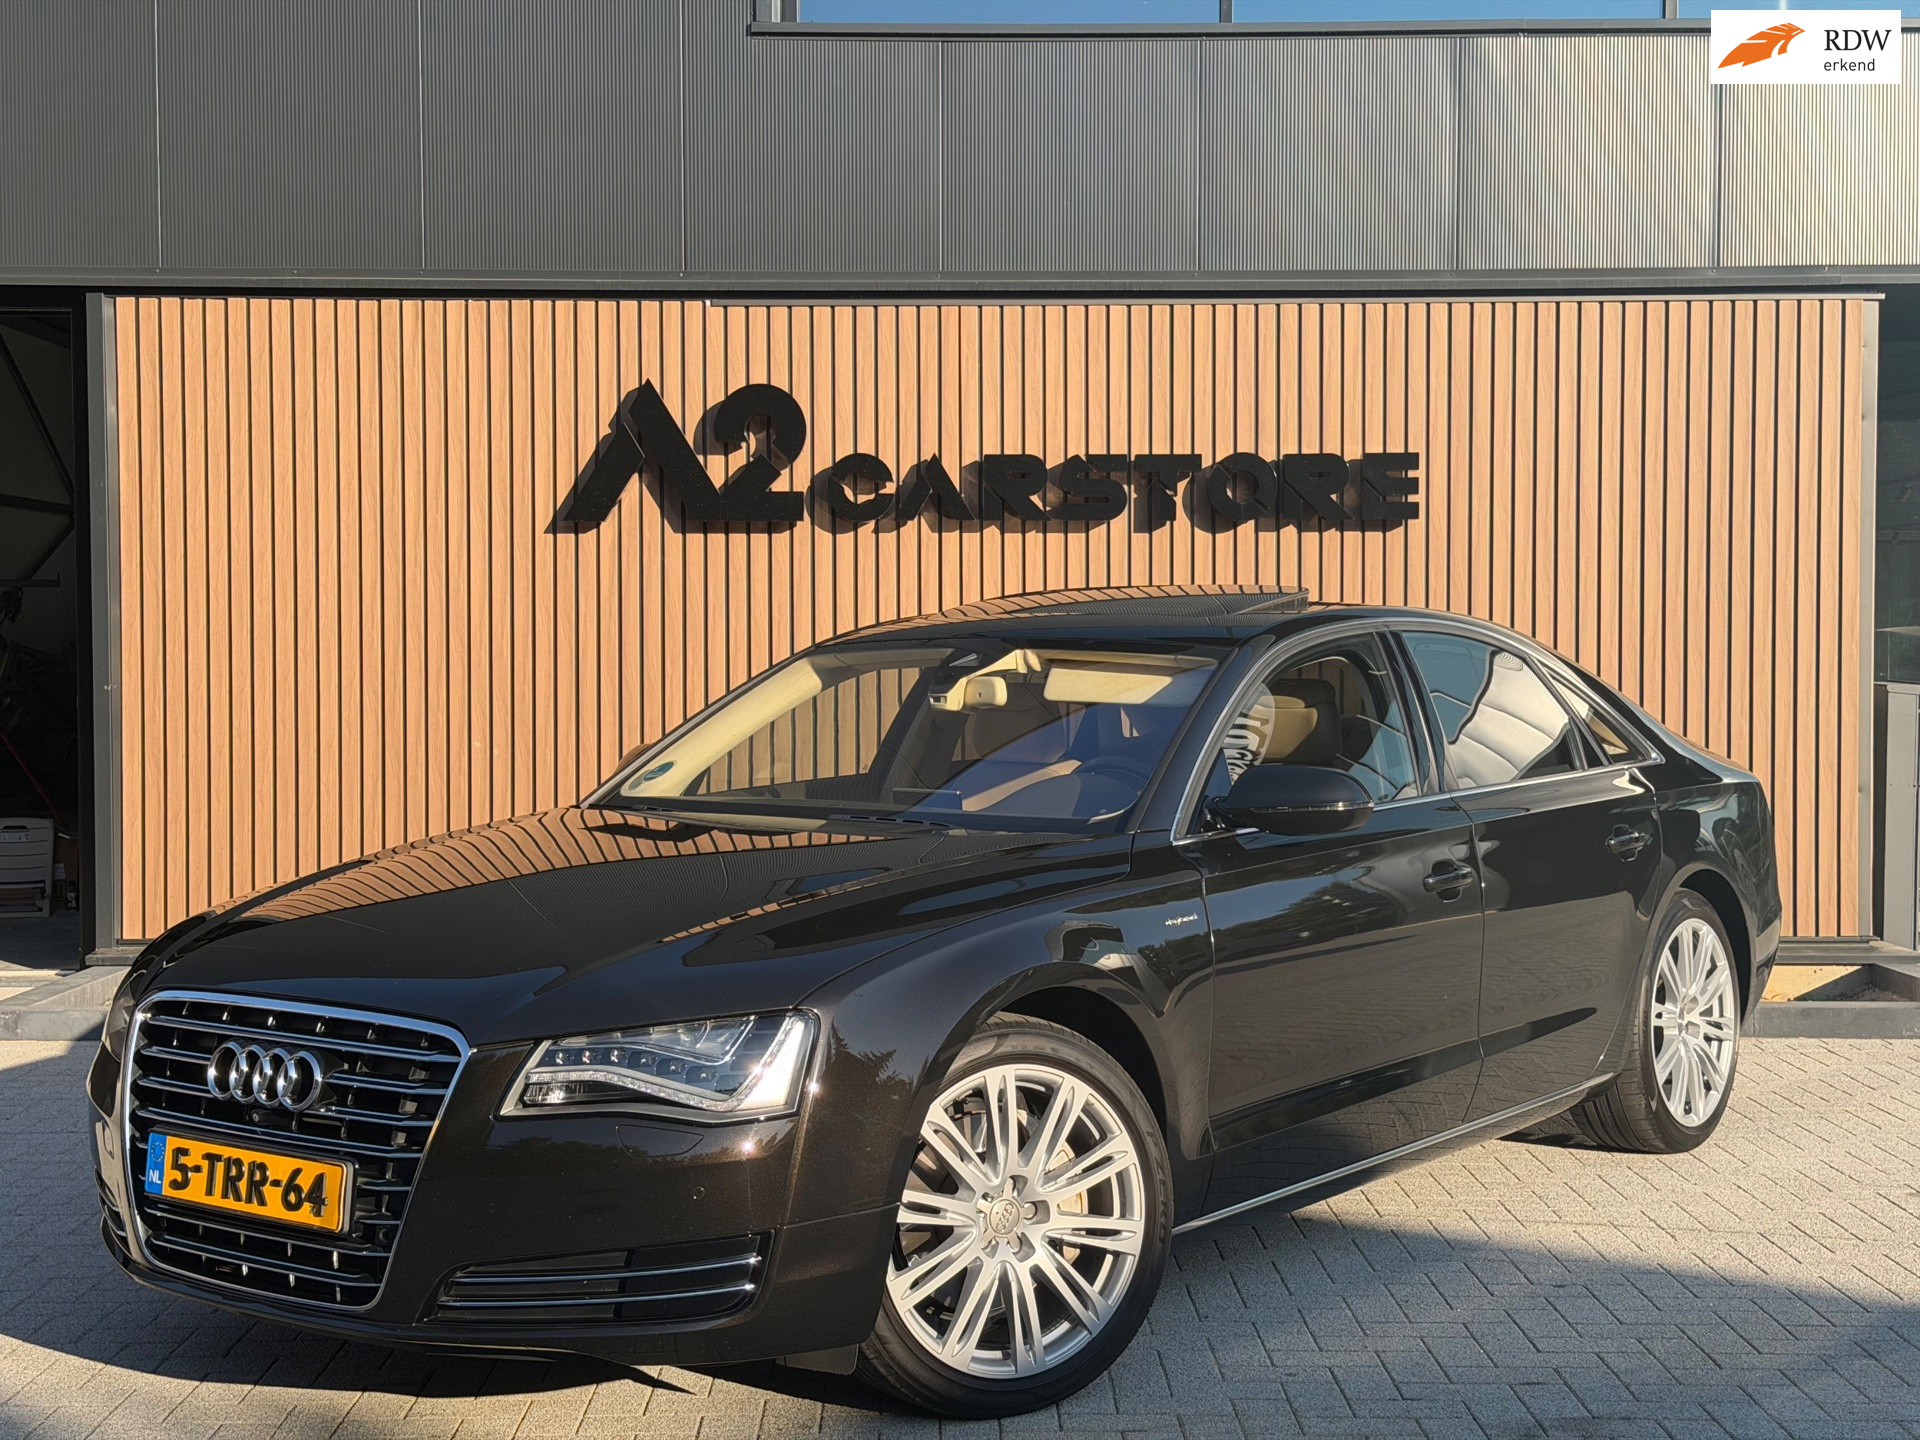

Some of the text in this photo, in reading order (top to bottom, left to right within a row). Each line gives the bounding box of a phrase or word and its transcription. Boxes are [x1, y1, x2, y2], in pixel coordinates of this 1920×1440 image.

[560, 378, 1420, 523] A2 CARSTORE
[149, 1169, 162, 1184] NL
[168, 1147, 328, 1218] 5-TRR-64
